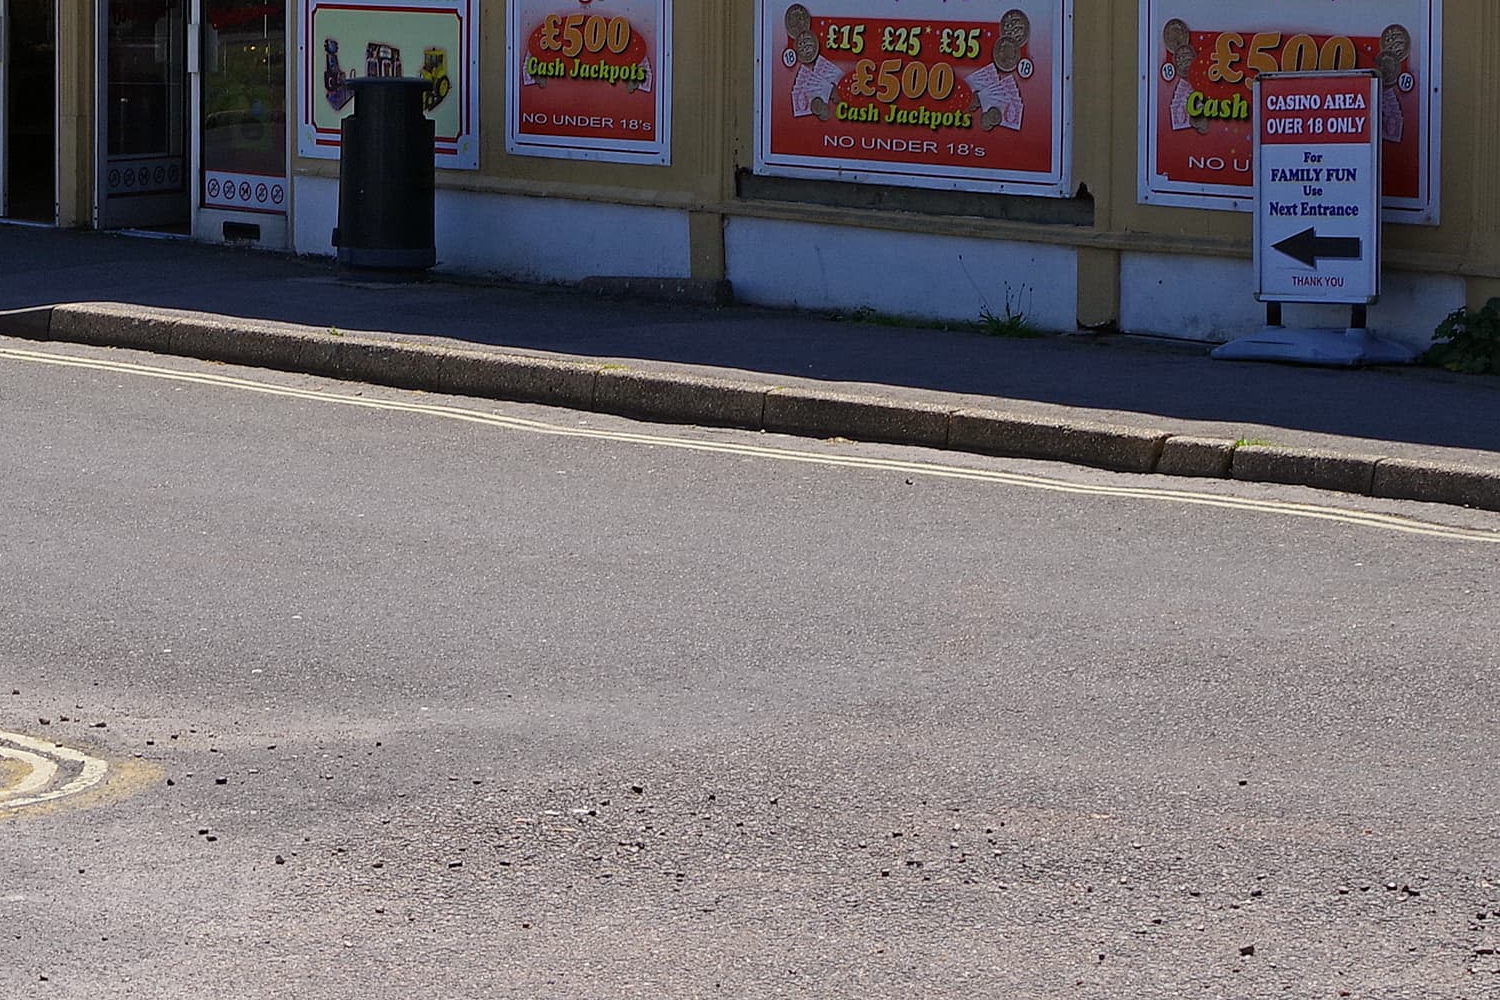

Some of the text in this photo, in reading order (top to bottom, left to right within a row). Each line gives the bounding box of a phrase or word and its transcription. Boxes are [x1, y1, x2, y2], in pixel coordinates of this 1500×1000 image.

[826, 24, 981, 59] £15 £25 £35
[849, 58, 956, 103] £500
[1266, 93, 1366, 111] CASINO AREA
[835, 101, 973, 131] Cash Jackpots
[1266, 116, 1366, 135] OVER 18 ONLY
[823, 134, 986, 157] NO UNDER 18's
[1303, 151, 1322, 163] For
[1270, 167, 1357, 183] FAMILY FUN
[1302, 185, 1323, 197] Use
[1269, 201, 1359, 217] Next Entrance
[1291, 275, 1344, 288] THANK YOU
